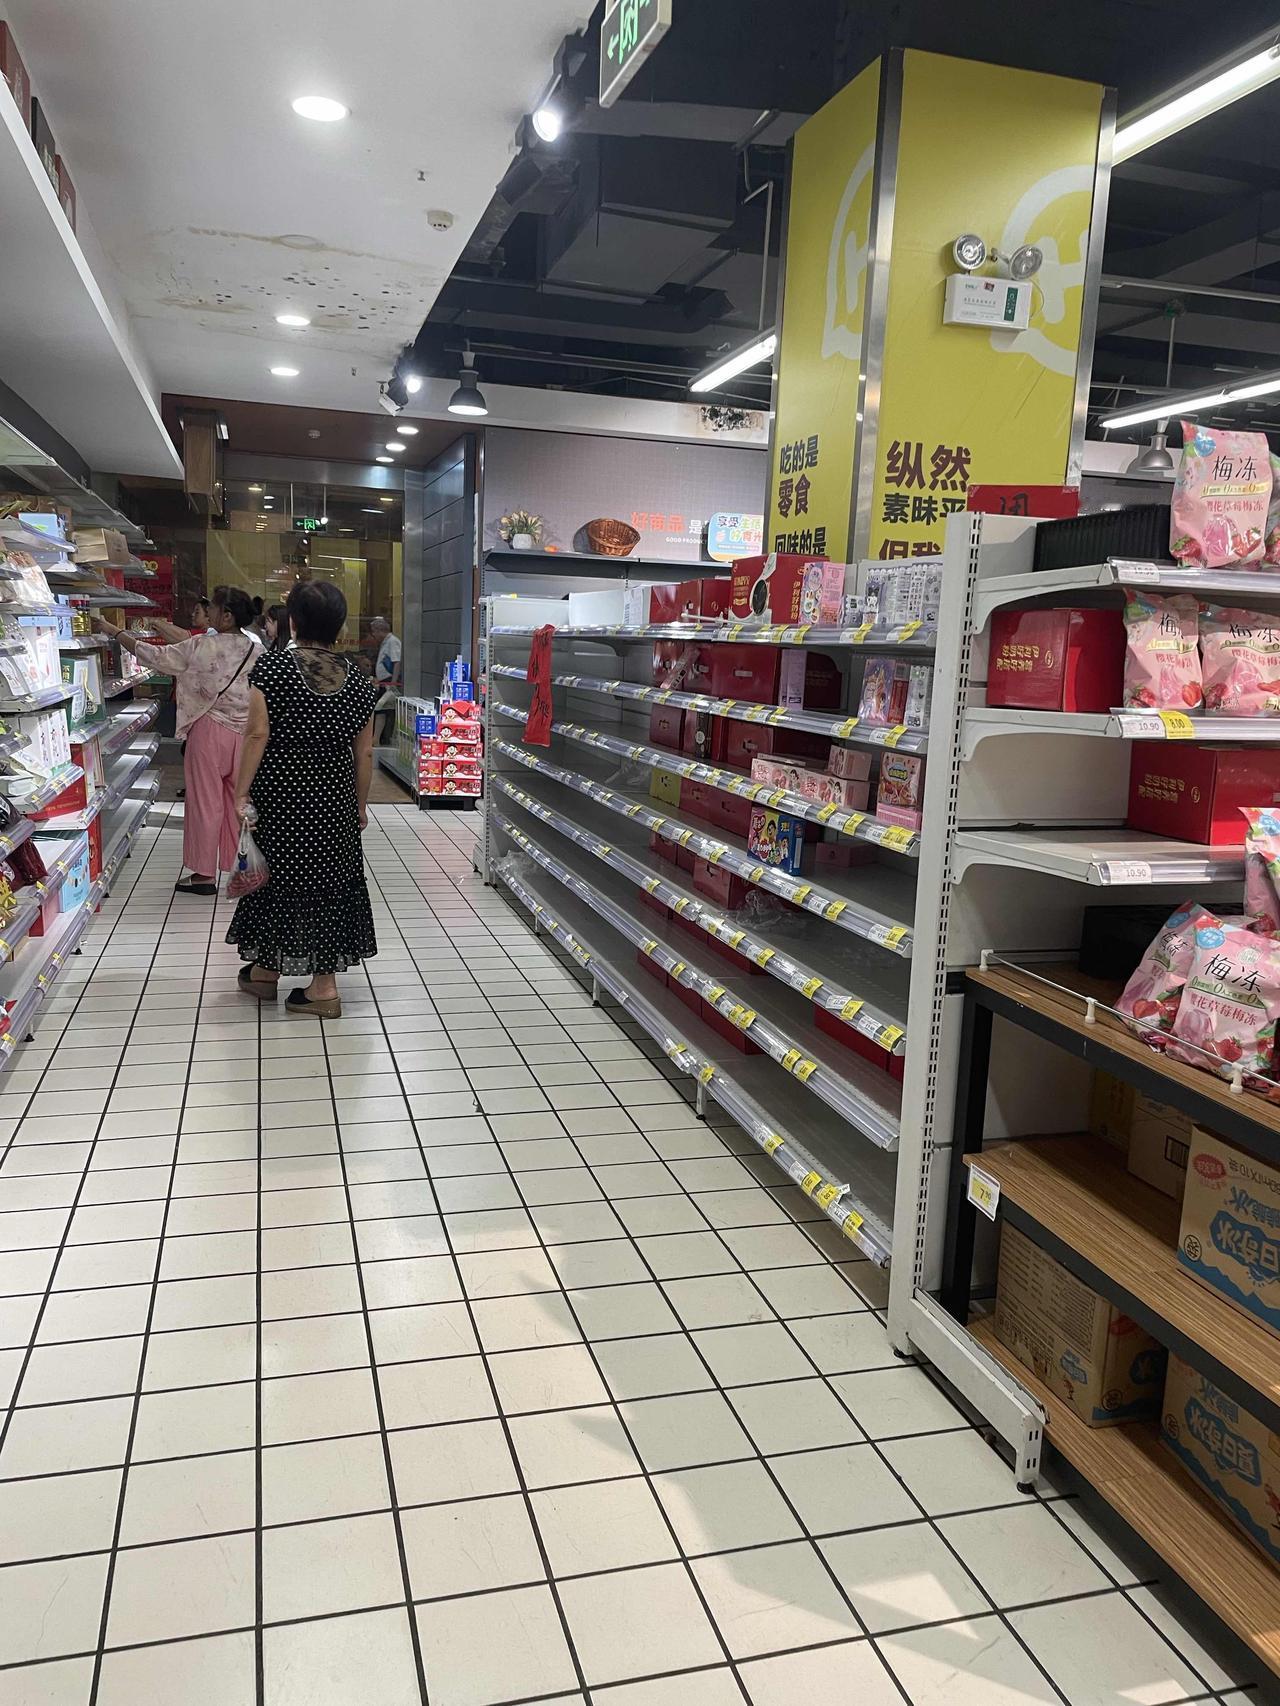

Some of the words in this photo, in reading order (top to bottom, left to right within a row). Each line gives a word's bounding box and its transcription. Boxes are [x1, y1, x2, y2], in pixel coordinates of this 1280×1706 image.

[780, 434, 818, 475] 吃的是
[884, 440, 971, 493] 纵然
[1211, 454, 1259, 482] 梅冻
[778, 474, 811, 520] 零食
[1138, 722, 1160, 732] 10.90
[1203, 953, 1266, 993] 梅冻
